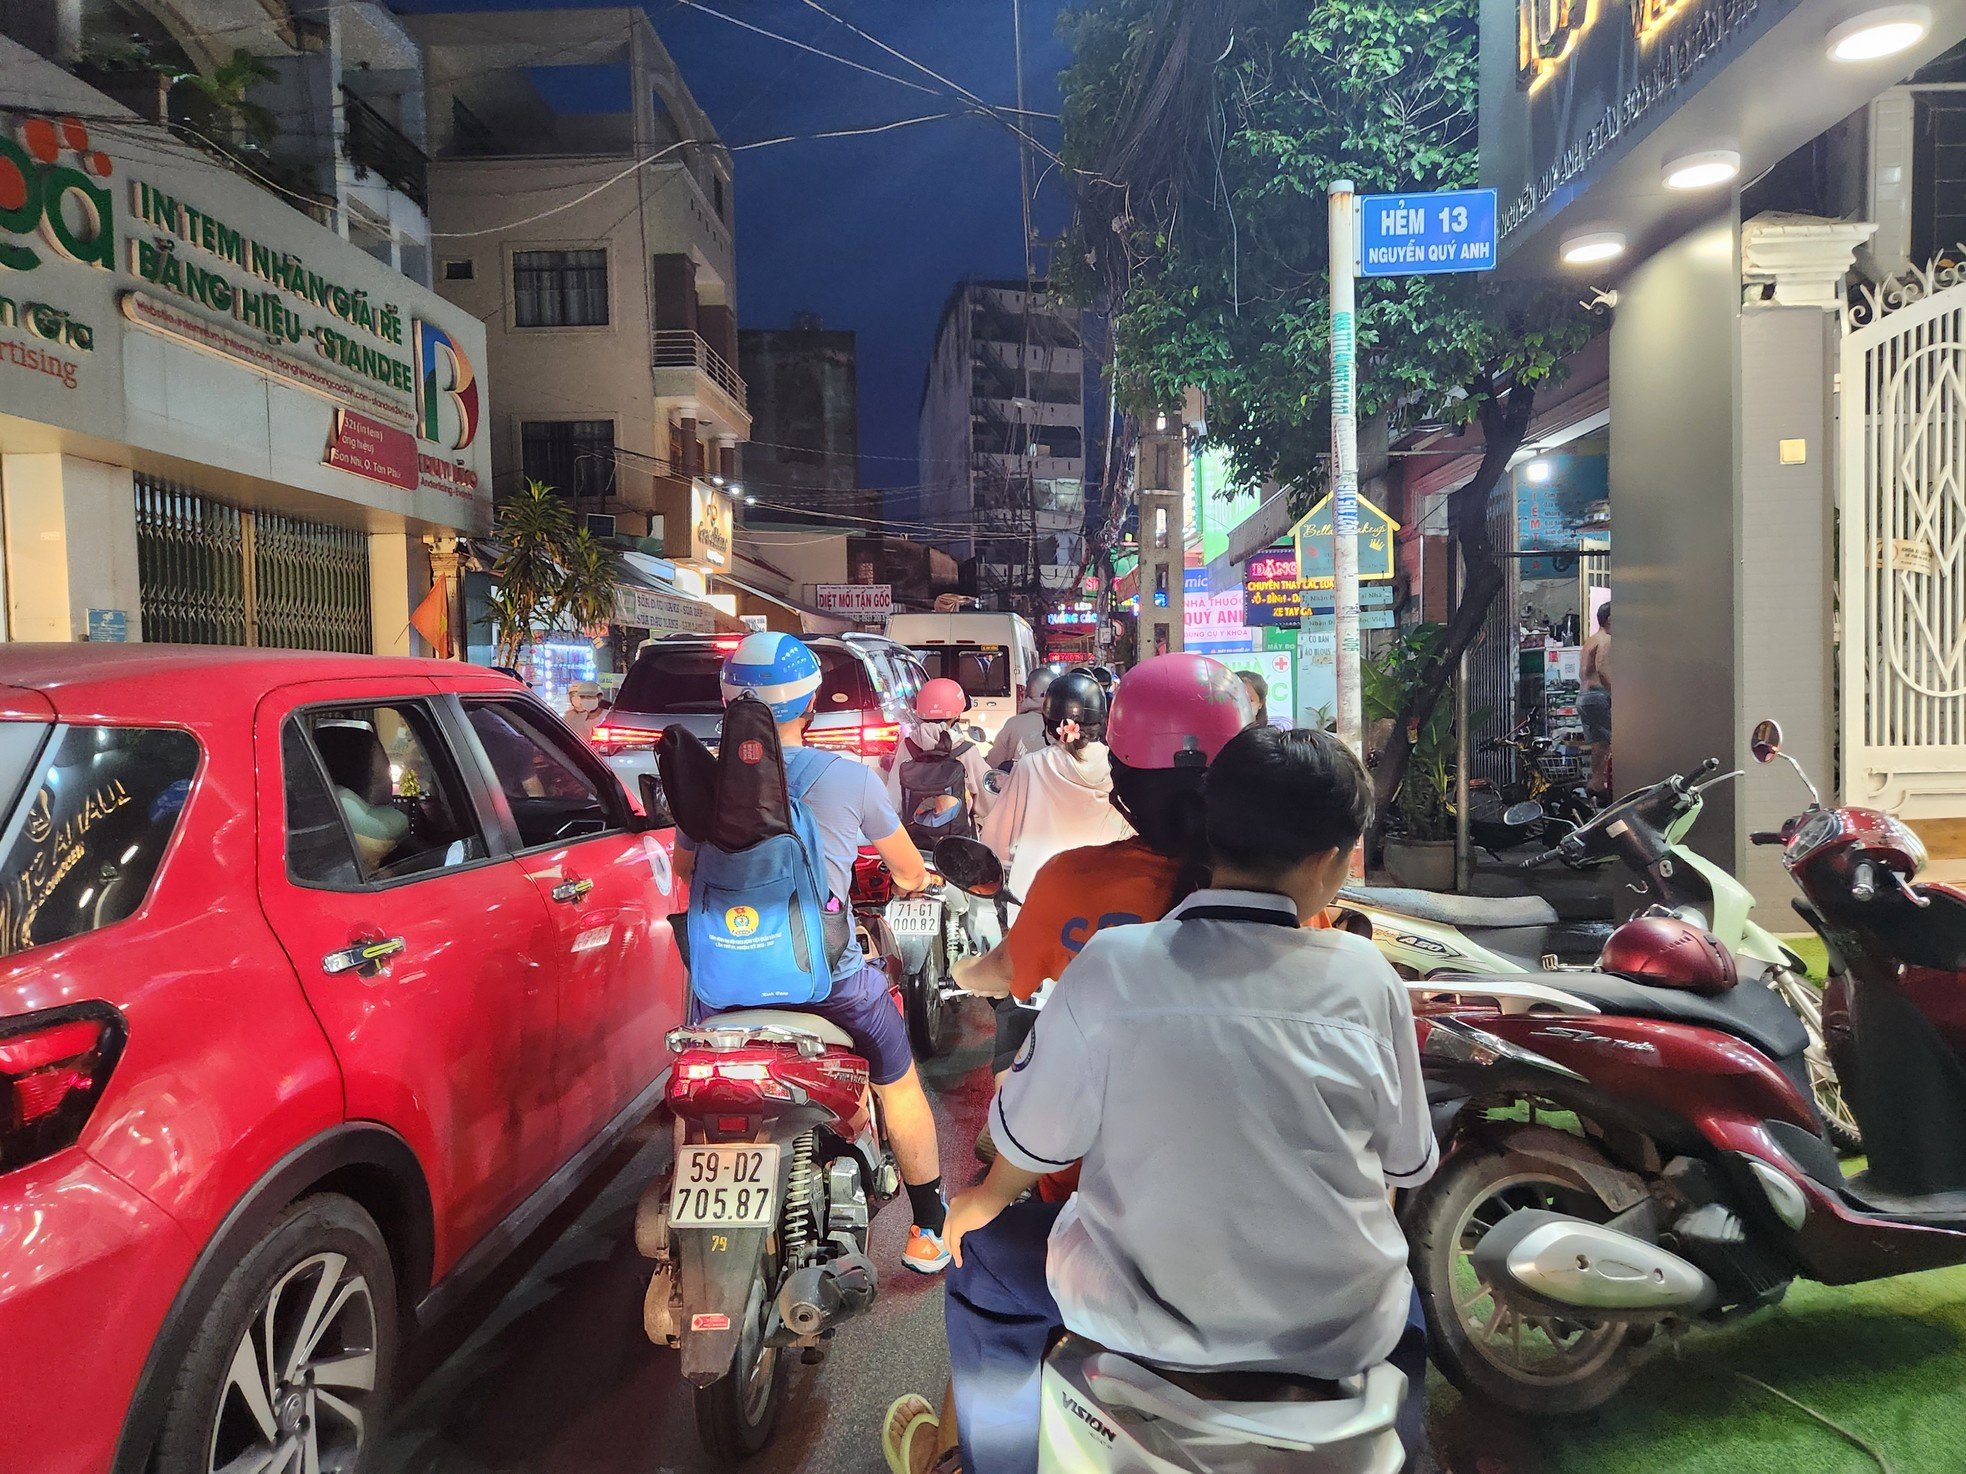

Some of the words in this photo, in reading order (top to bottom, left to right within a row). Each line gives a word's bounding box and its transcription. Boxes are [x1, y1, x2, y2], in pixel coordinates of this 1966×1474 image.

[1381, 200, 1425, 236] HẺM
[1439, 206, 1468, 232] 13
[1369, 239, 1424, 264] NGUYỄN
[1428, 240, 1457, 261] QUÝ
[1460, 242, 1490, 260] ANH
[132, 236, 232, 312] BẢNG
[235, 288, 299, 345] HIỆU
[317, 326, 412, 393] STANDEE
[1248, 578, 1280, 591] CHUYÊN
[819, 591, 836, 611] DIỆT
[839, 590, 853, 608] MỐI
[873, 589, 890, 608] GỐC
[898, 903, 933, 917] 71-G1
[893, 917, 936, 931] 000.82
[690, 1152, 763, 1183] 59-D2
[676, 1188, 769, 1221] 705.87
[711, 1235, 728, 1251] 79
[1061, 1391, 1117, 1443] VISION
